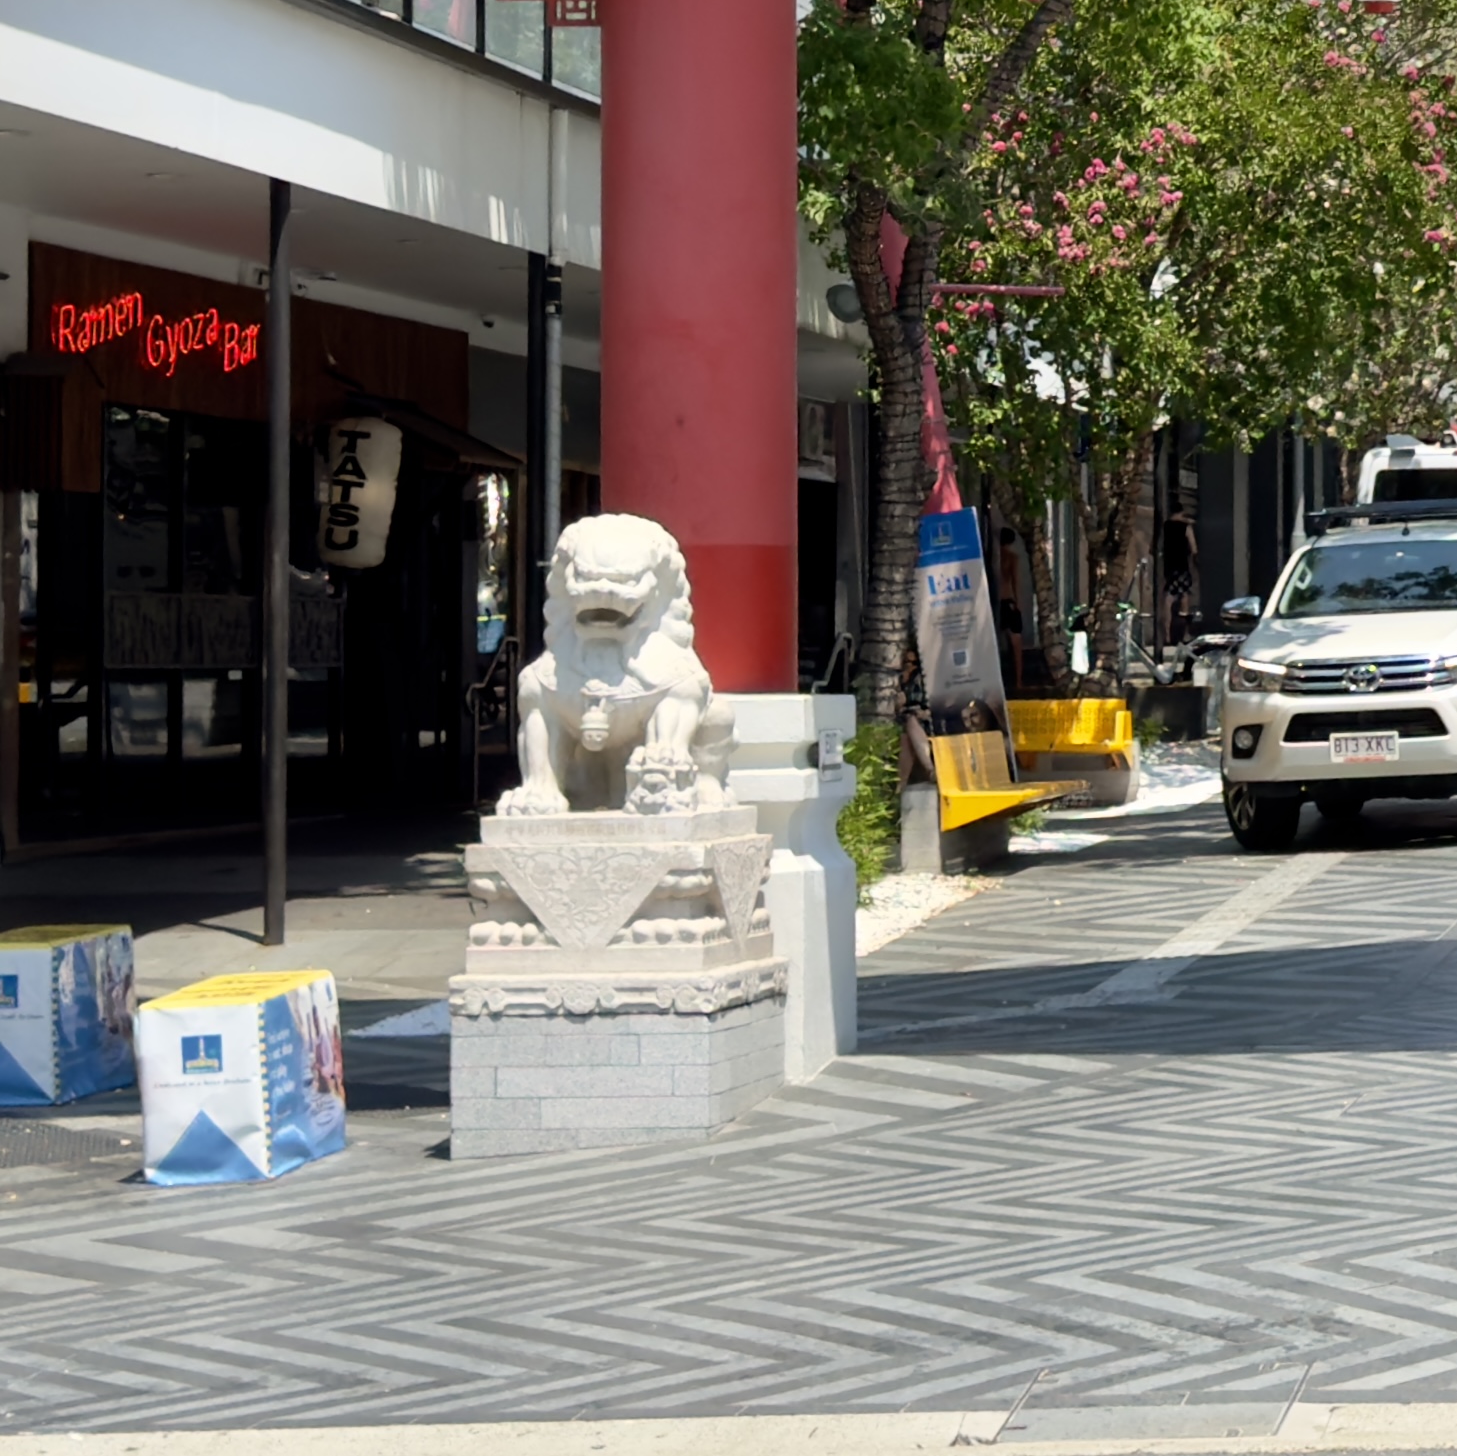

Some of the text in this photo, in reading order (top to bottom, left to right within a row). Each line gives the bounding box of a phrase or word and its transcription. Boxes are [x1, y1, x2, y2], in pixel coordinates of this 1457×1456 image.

[57, 291, 262, 377] Ramen Gyoza Bar
[324, 429, 372, 551] TATSU
